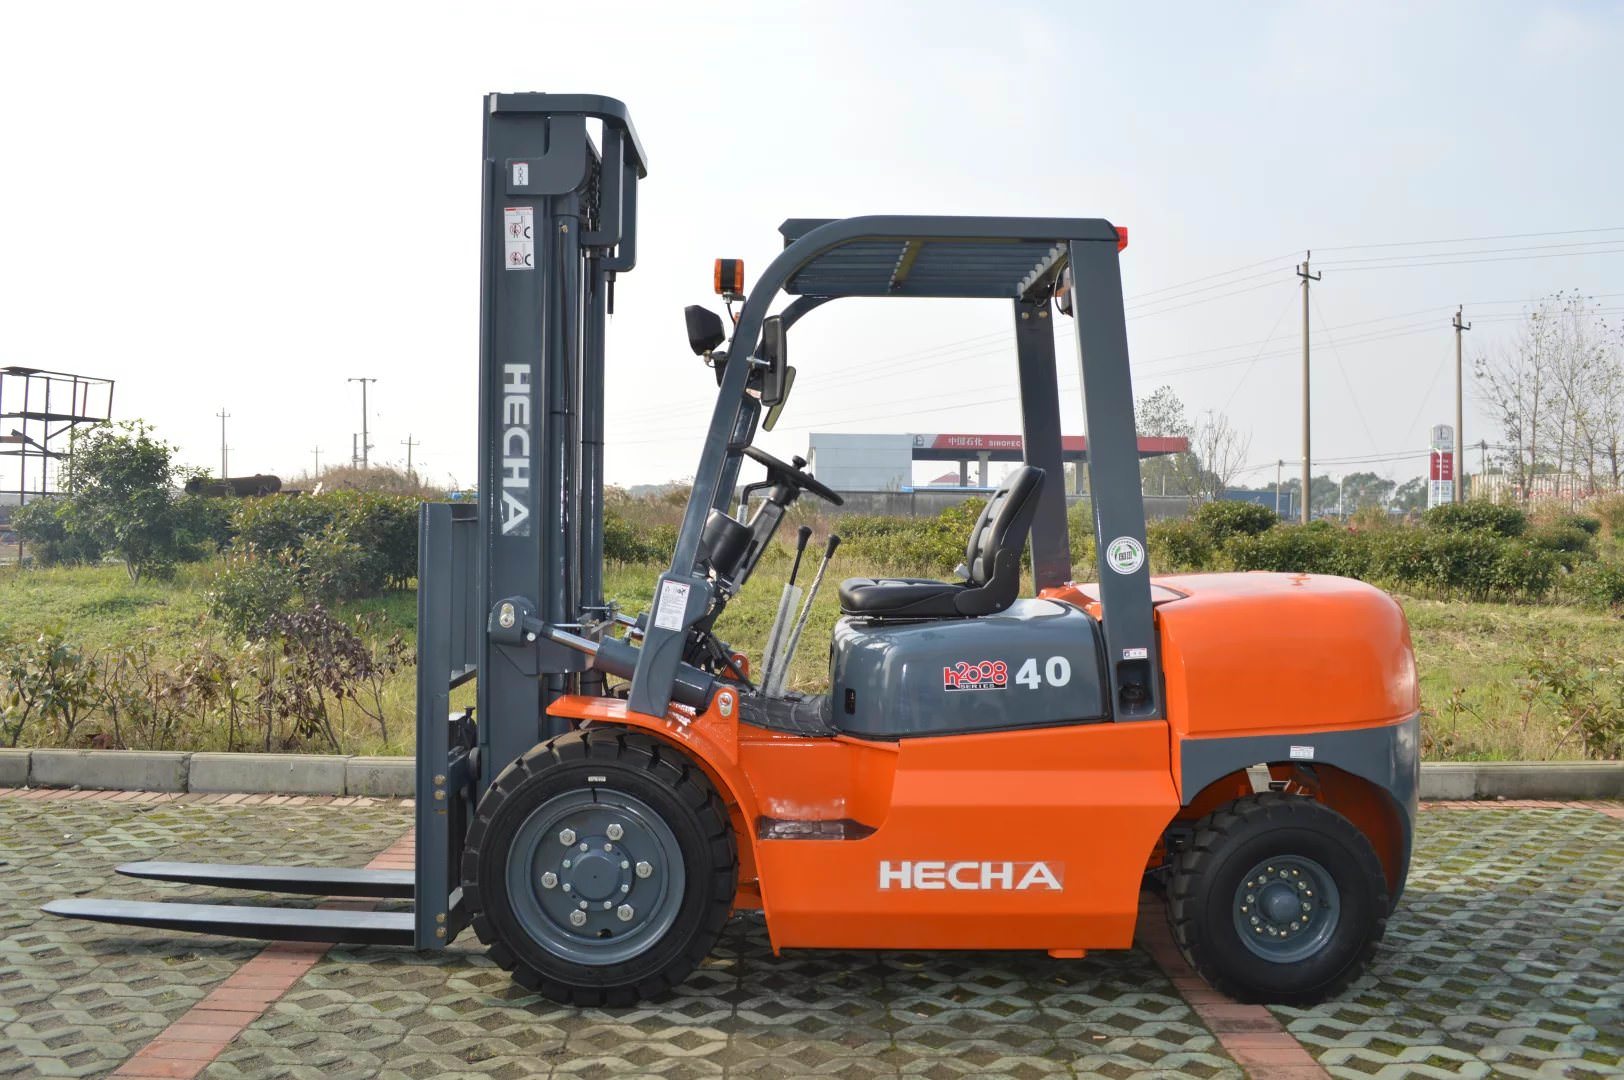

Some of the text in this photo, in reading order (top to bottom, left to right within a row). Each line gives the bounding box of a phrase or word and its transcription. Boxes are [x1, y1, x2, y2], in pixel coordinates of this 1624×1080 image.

[502, 364, 531, 535] HECHA
[948, 436, 983, 446] 中国石化
[960, 682, 995, 690] SERIES
[1015, 656, 1072, 690] 40
[879, 860, 1063, 891] HECHA
